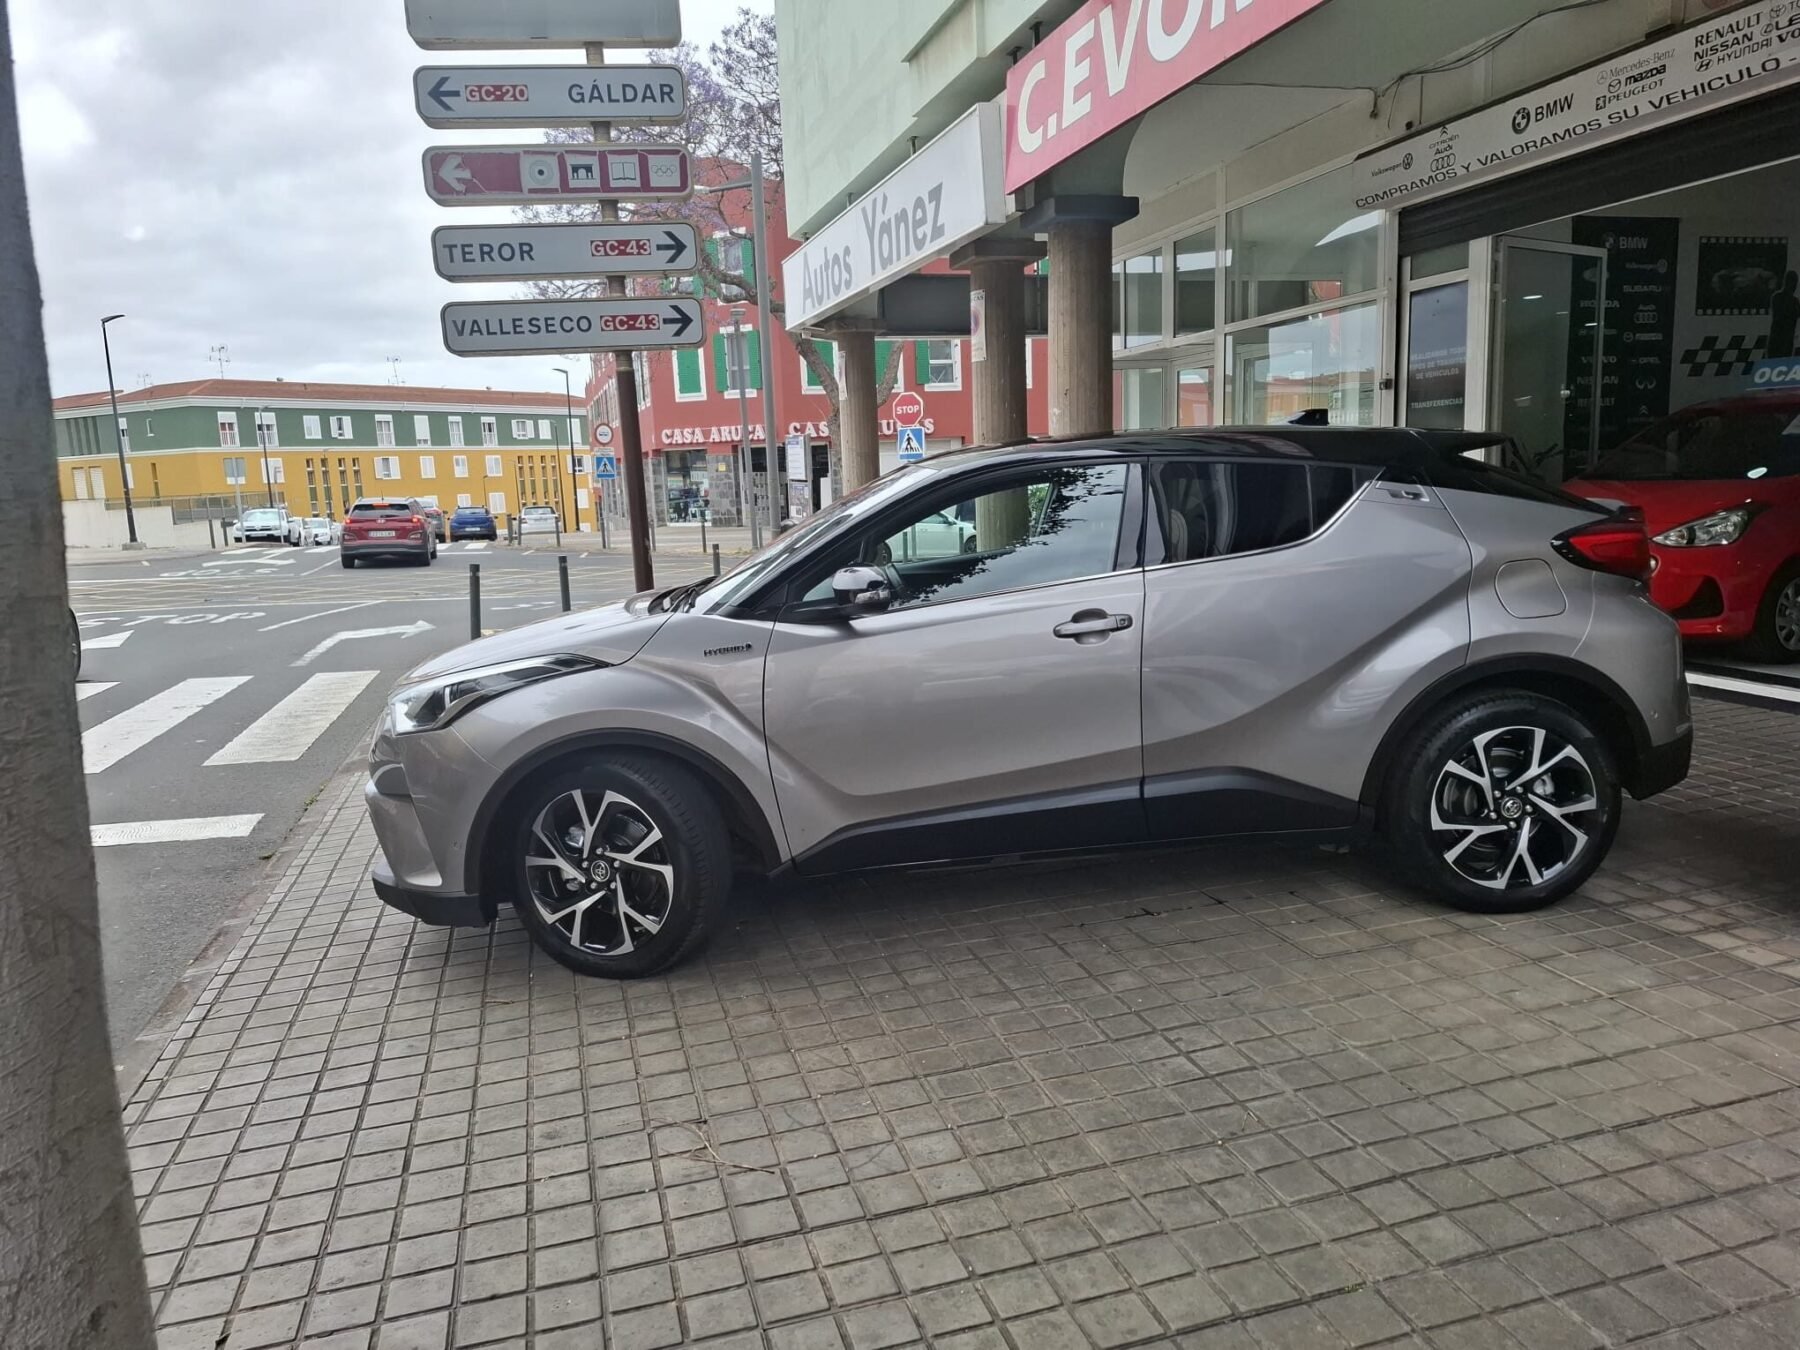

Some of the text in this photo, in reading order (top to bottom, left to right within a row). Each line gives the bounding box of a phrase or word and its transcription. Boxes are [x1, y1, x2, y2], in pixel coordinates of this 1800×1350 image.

[1694, 11, 1764, 49] RENAULT
[1694, 31, 1754, 62] NISSAN
[1717, 38, 1773, 65] HYUNDAI
[1610, 48, 1676, 78] Mercedes-Benz
[466, 79, 676, 104] GC-20 GÁLDAR
[1608, 78, 1665, 104] PEUGEOT
[1534, 92, 1575, 123] BMW
[1355, 168, 1458, 208] COMPRAMOS
[1461, 162, 1472, 173] Y
[1477, 118, 1602, 166] VALORAMOS
[1608, 105, 1640, 125] SU
[1648, 57, 1781, 109] VEHICULO
[1434, 143, 1453, 156] Audi
[442, 240, 651, 263] TEROR GC-43
[802, 182, 945, 314] Autos Yánez
[1620, 237, 1648, 249] BMW
[1580, 300, 1620, 308] HODA
[452, 314, 660, 337] VALLESECO GC-43
[1577, 376, 1619, 385] NISAN
[896, 404, 920, 415] STOP
[661, 428, 704, 445] CASA
[788, 421, 829, 438] CAS
